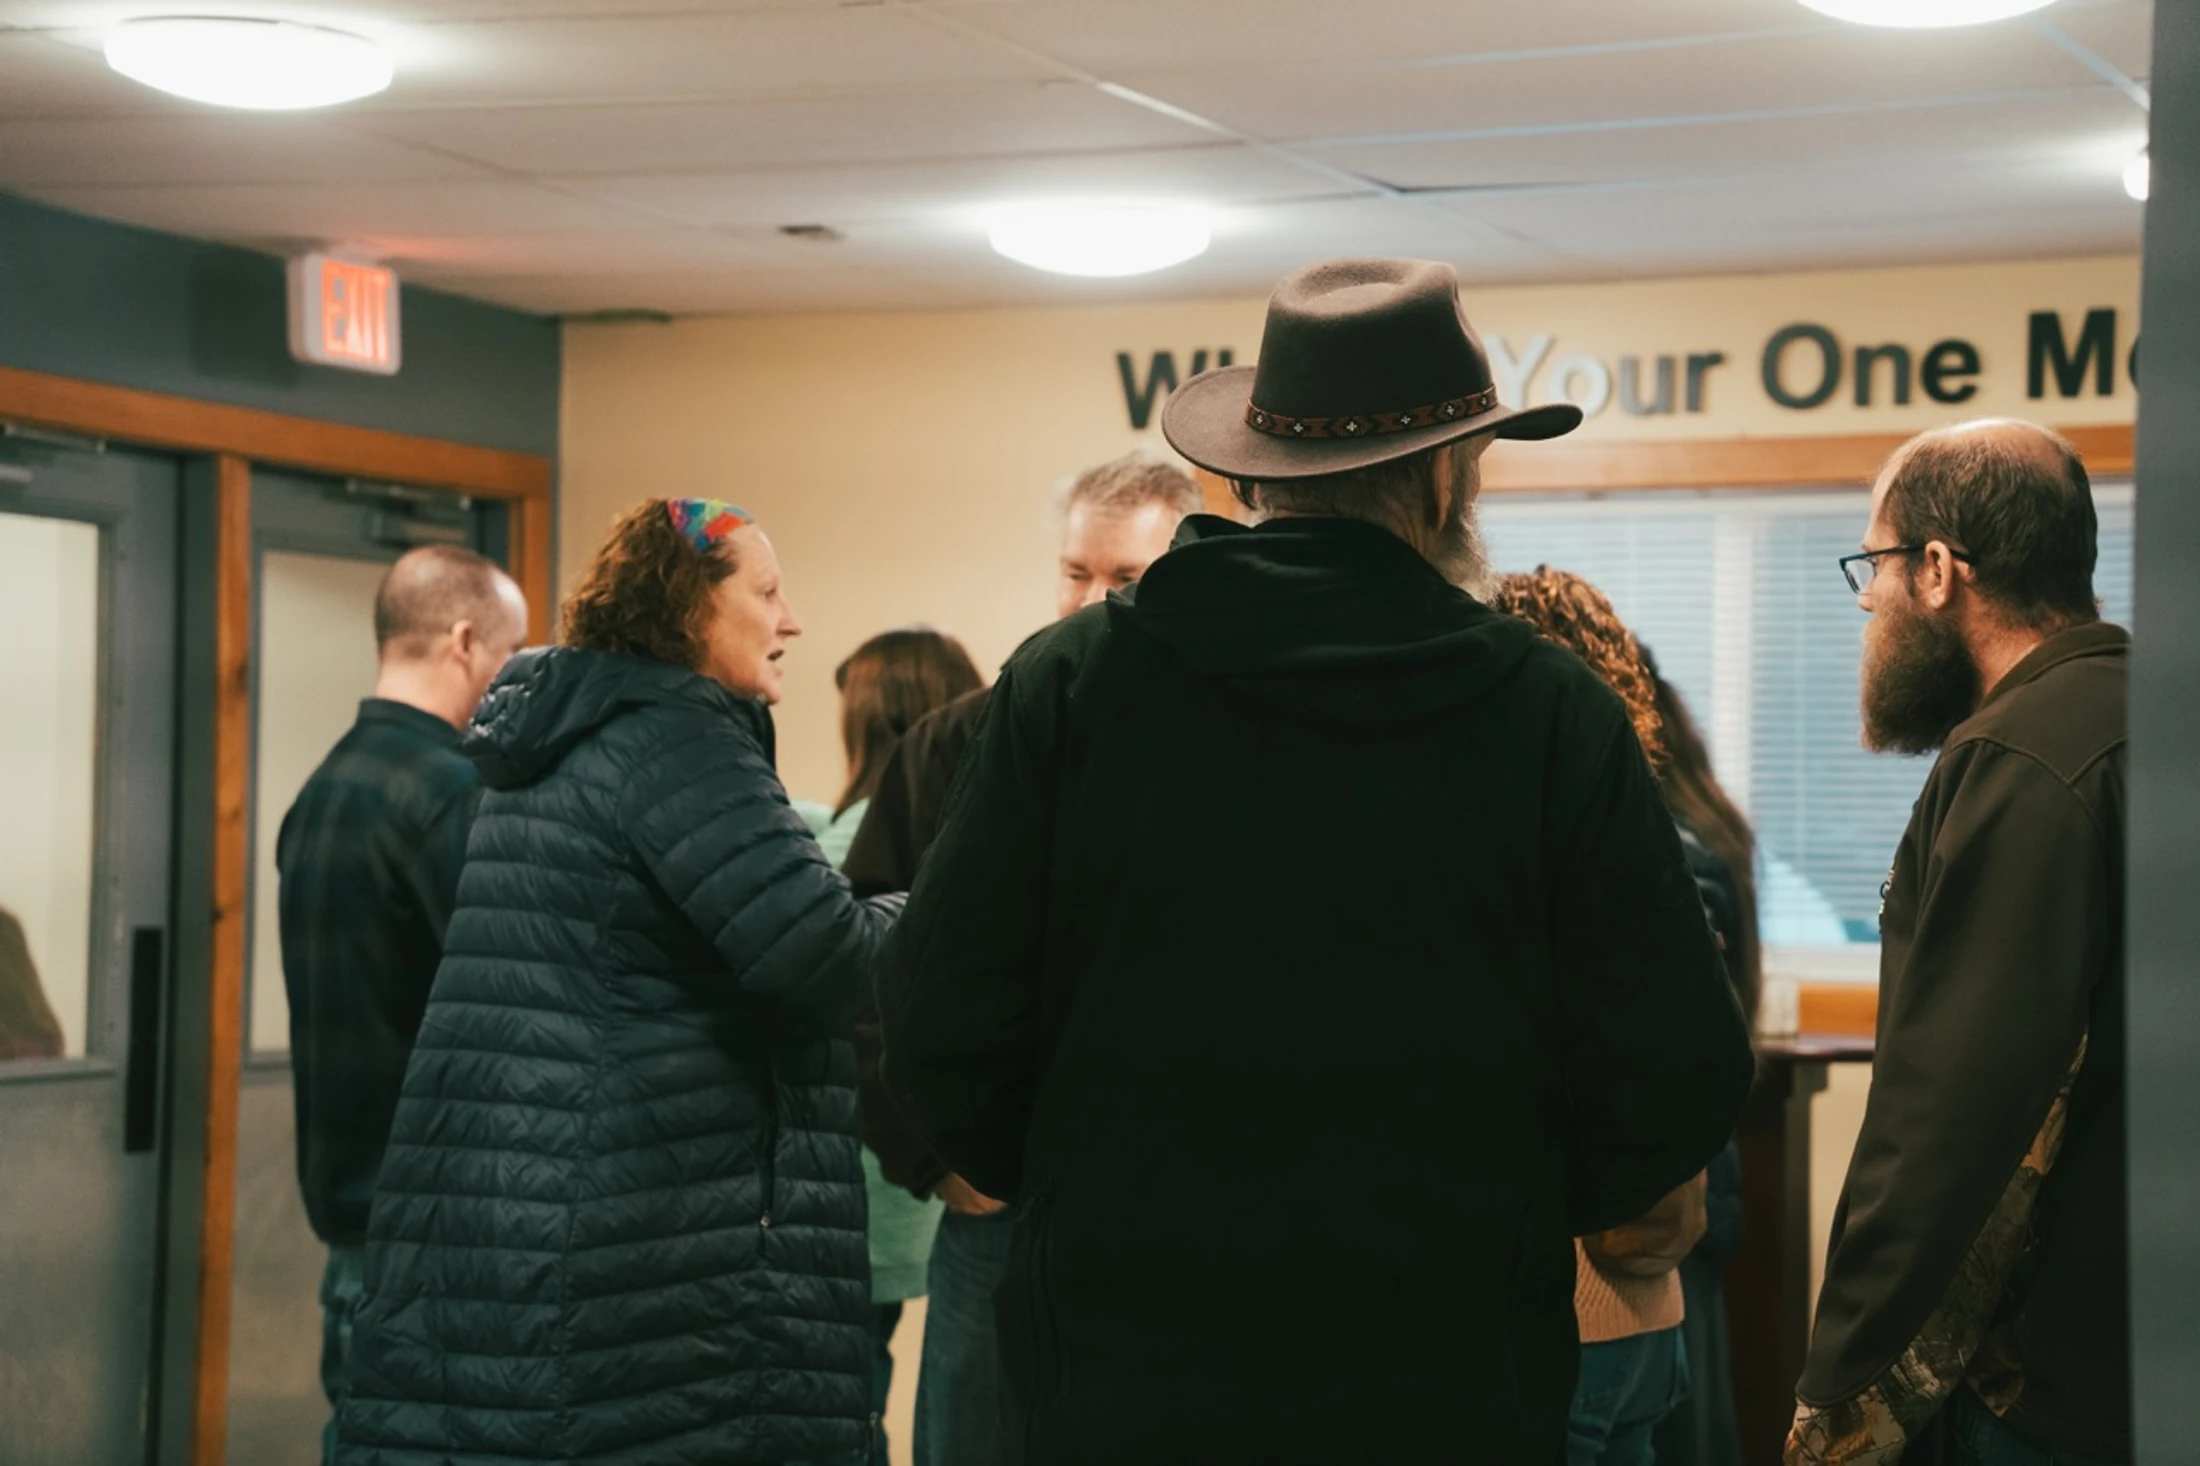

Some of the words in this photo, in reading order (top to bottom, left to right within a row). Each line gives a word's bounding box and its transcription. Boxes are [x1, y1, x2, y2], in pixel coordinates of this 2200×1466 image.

[322, 258, 390, 360] EXIT
[1115, 349, 1232, 430] W
[1484, 335, 1724, 417] Your
[1761, 322, 1981, 410] One
[2027, 307, 2140, 398] M
